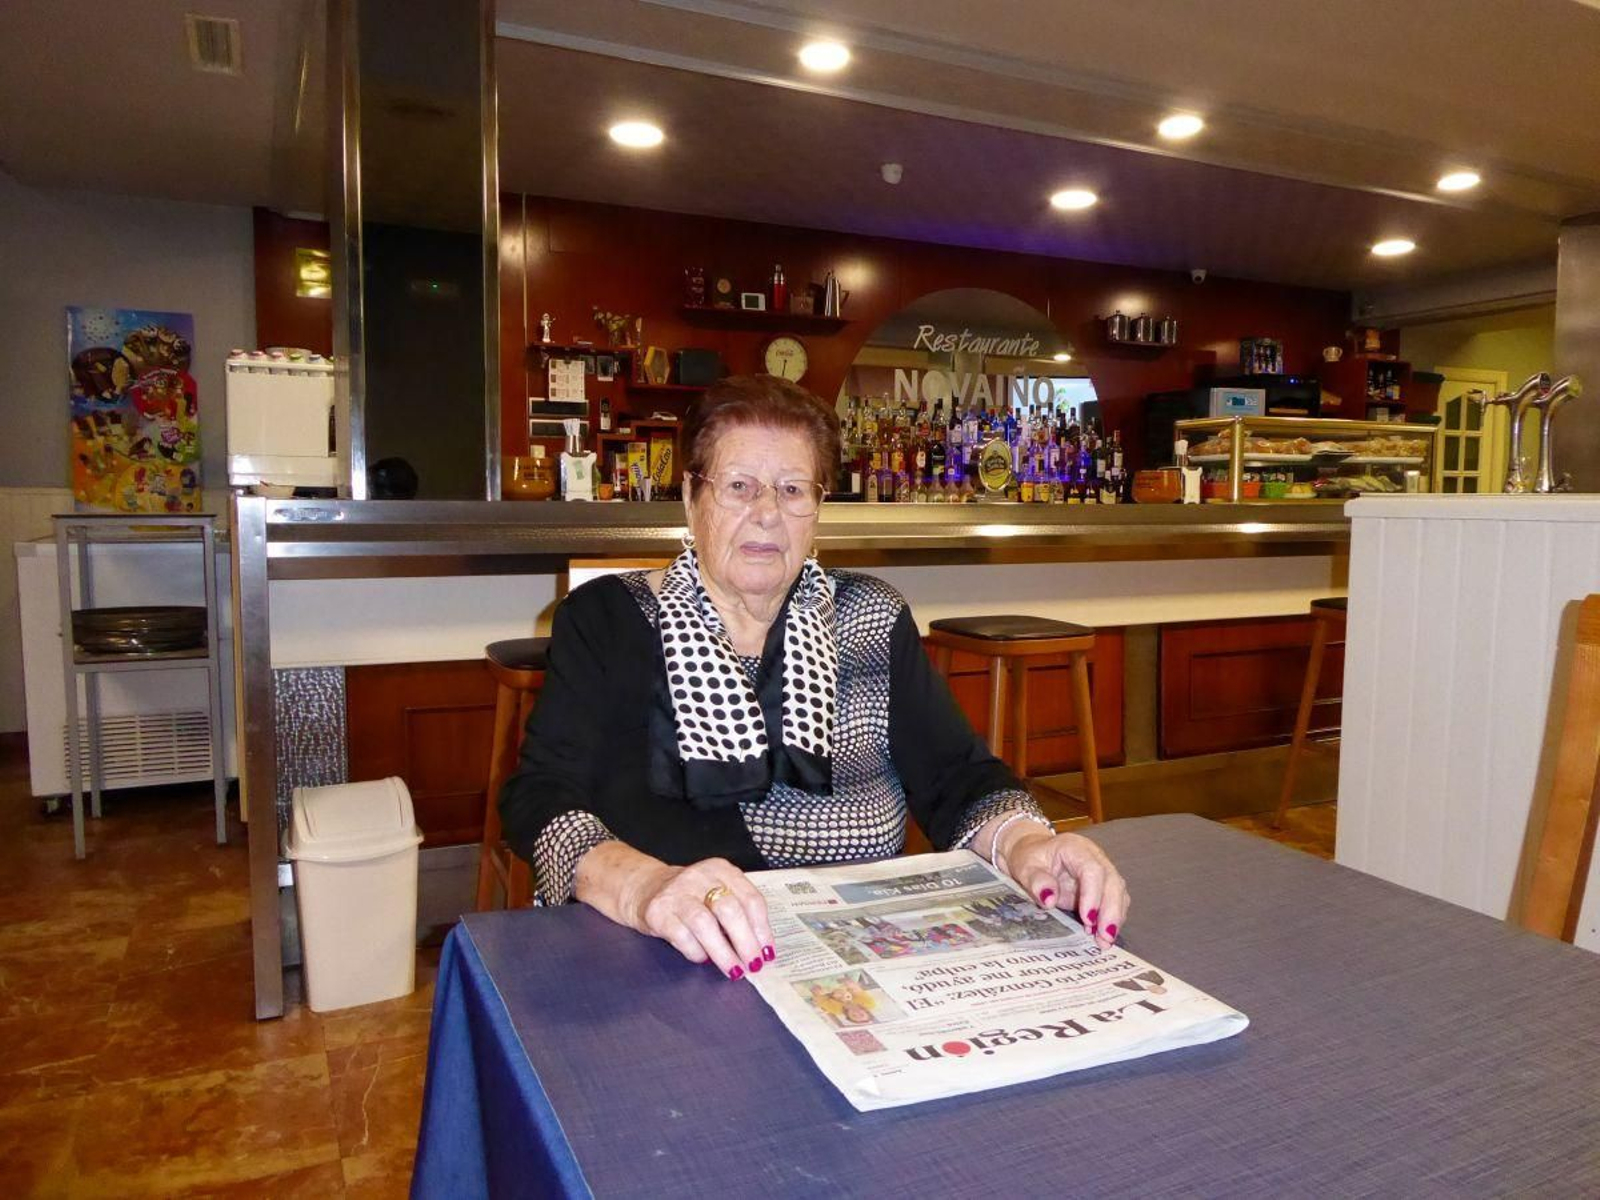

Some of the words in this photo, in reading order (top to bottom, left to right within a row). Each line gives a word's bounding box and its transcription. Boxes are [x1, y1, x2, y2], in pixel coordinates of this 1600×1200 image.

[913, 325, 1041, 357] Restaurante
[981, 959, 1002, 973] la
[1005, 952, 1053, 969] tuvo
[1020, 954, 1119, 978] conductor
[1053, 949, 1080, 962] no
[900, 972, 976, 995] ayudó,
[980, 968, 1014, 985] me
[1056, 960, 1137, 988] Rosario
[948, 977, 1053, 1002] González:
[1088, 1000, 1166, 1026] La
[903, 1019, 1093, 1061] Región
